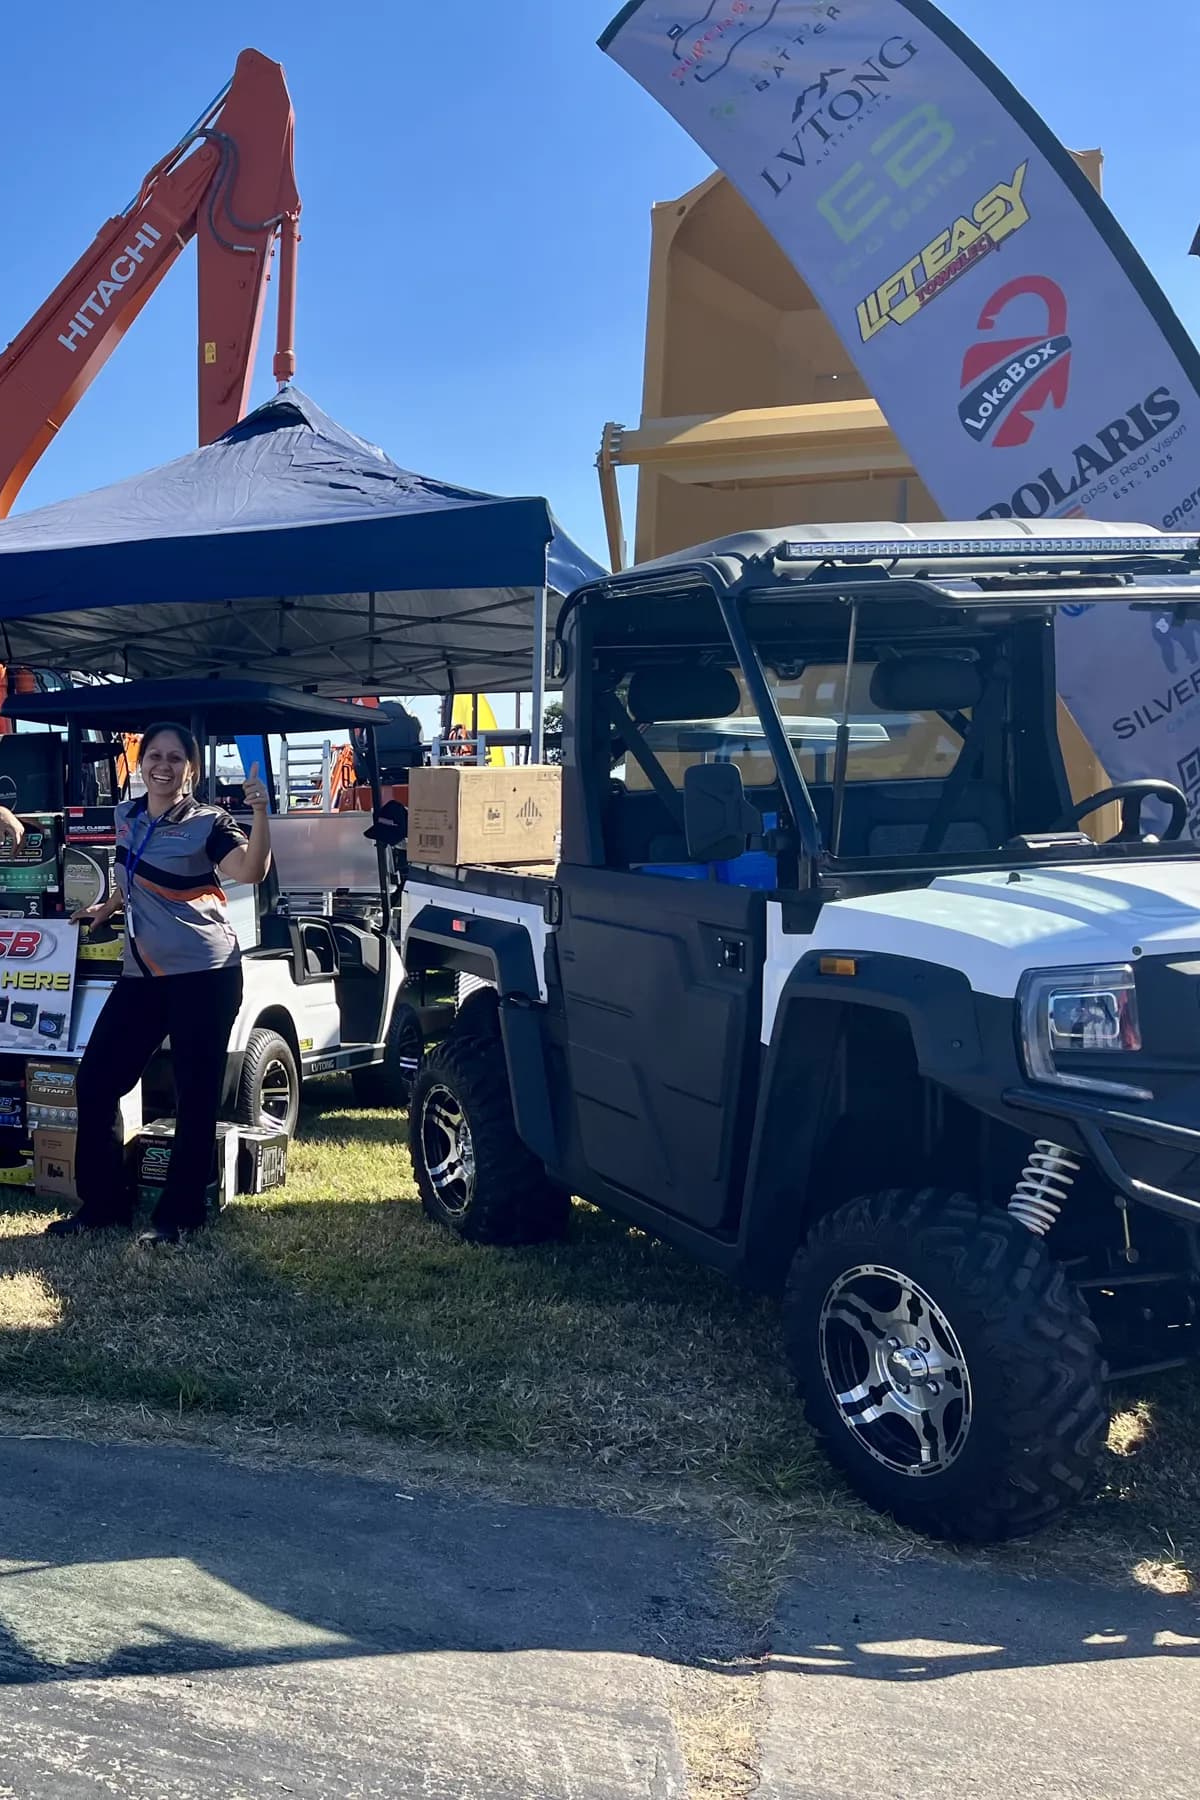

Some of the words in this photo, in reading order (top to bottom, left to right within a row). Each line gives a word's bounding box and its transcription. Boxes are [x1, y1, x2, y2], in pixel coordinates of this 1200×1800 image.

[761, 36, 919, 198] LVTONG
[855, 158, 1031, 343] LIFTEASY
[57, 222, 162, 352] HITACHI
[965, 342, 1057, 430] LokaBox
[1120, 453, 1151, 478] Rear
[1150, 424, 1188, 455] Vision
[1144, 453, 1174, 479] 2005
[1, 970, 71, 991] HERE
[31, 1071, 75, 1087] SSB
